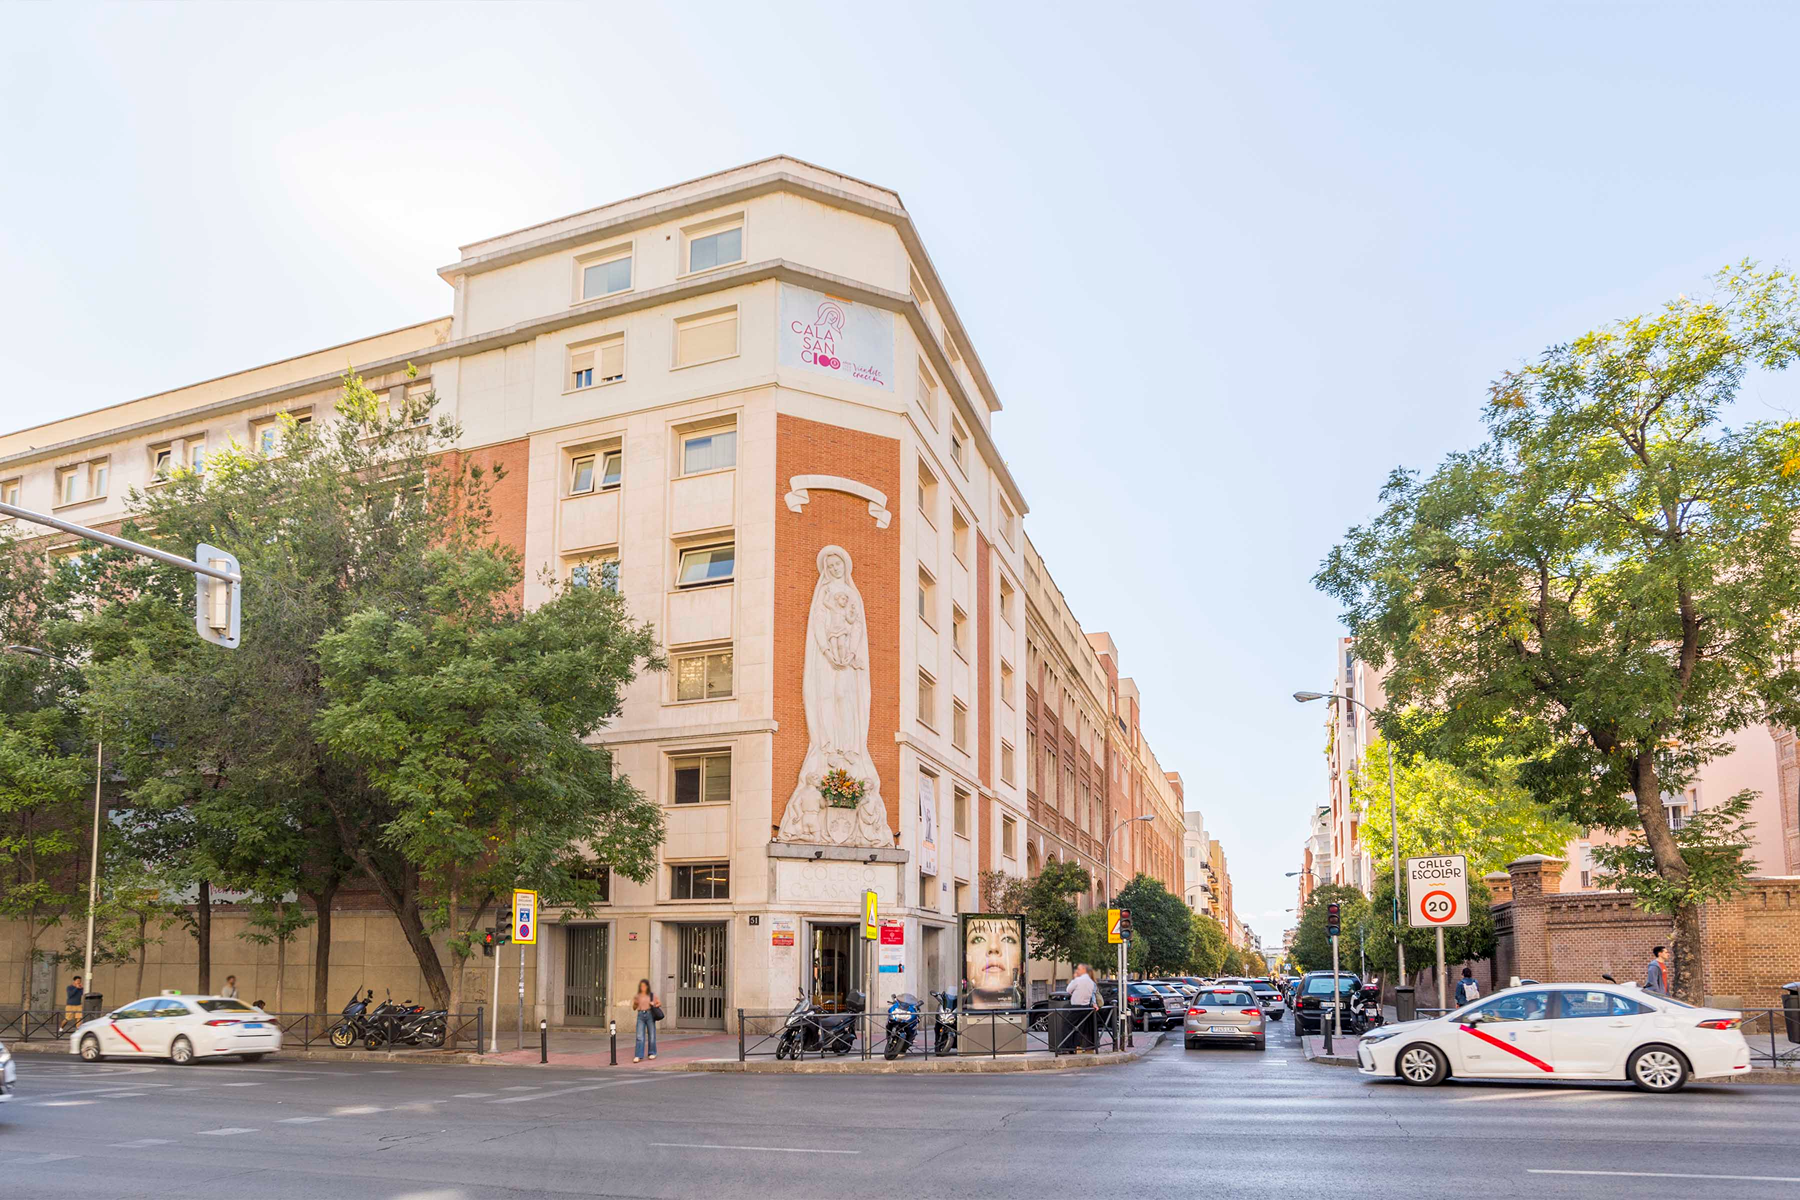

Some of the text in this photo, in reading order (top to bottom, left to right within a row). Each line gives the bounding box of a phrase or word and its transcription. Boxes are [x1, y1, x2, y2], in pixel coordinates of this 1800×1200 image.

[791, 320, 834, 342] CALA
[803, 337, 835, 355] SAN
[802, 866, 876, 882] COLEGIO
[1412, 868, 1461, 880] ESCOLAR
[790, 882, 886, 900] CALASANO
[1428, 901, 1449, 912] 20
[750, 916, 758, 924] 51
[970, 920, 1019, 934] ARMANI
